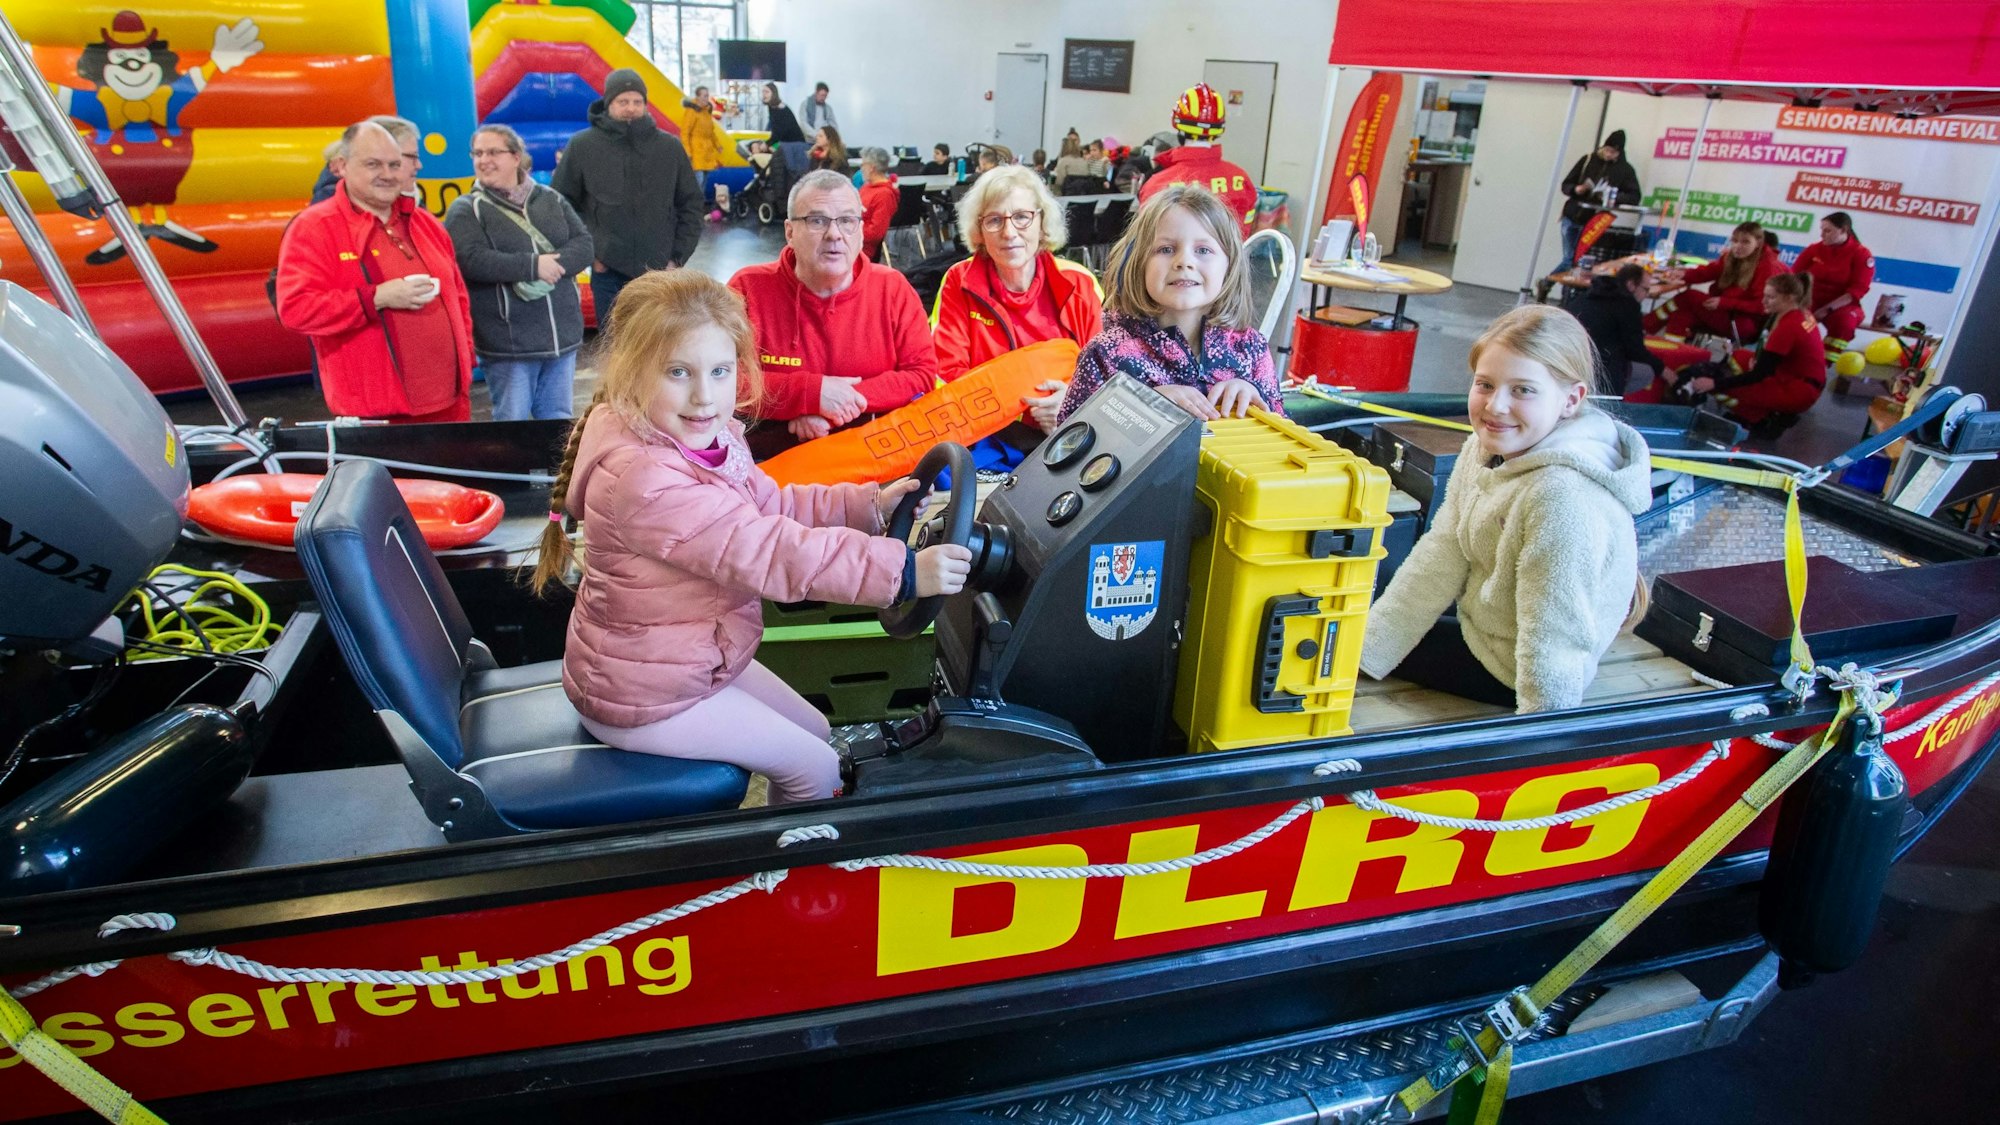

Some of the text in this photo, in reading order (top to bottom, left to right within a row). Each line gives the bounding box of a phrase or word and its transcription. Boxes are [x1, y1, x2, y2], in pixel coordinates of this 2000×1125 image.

[1781, 109, 1999, 141] SENIORENKARNEVAL
[1663, 140, 1843, 165] WEBERFASTNACHT
[1843, 177, 1873, 189] 10.02.
[1703, 204, 1748, 222] ZOCH
[1751, 210, 1808, 229] PARTY
[1795, 185, 1977, 221] KARNEVALSPARTY
[761, 354, 802, 367] DLRG
[864, 386, 1001, 460] DLRG
[876, 762, 1661, 977] DLRG
